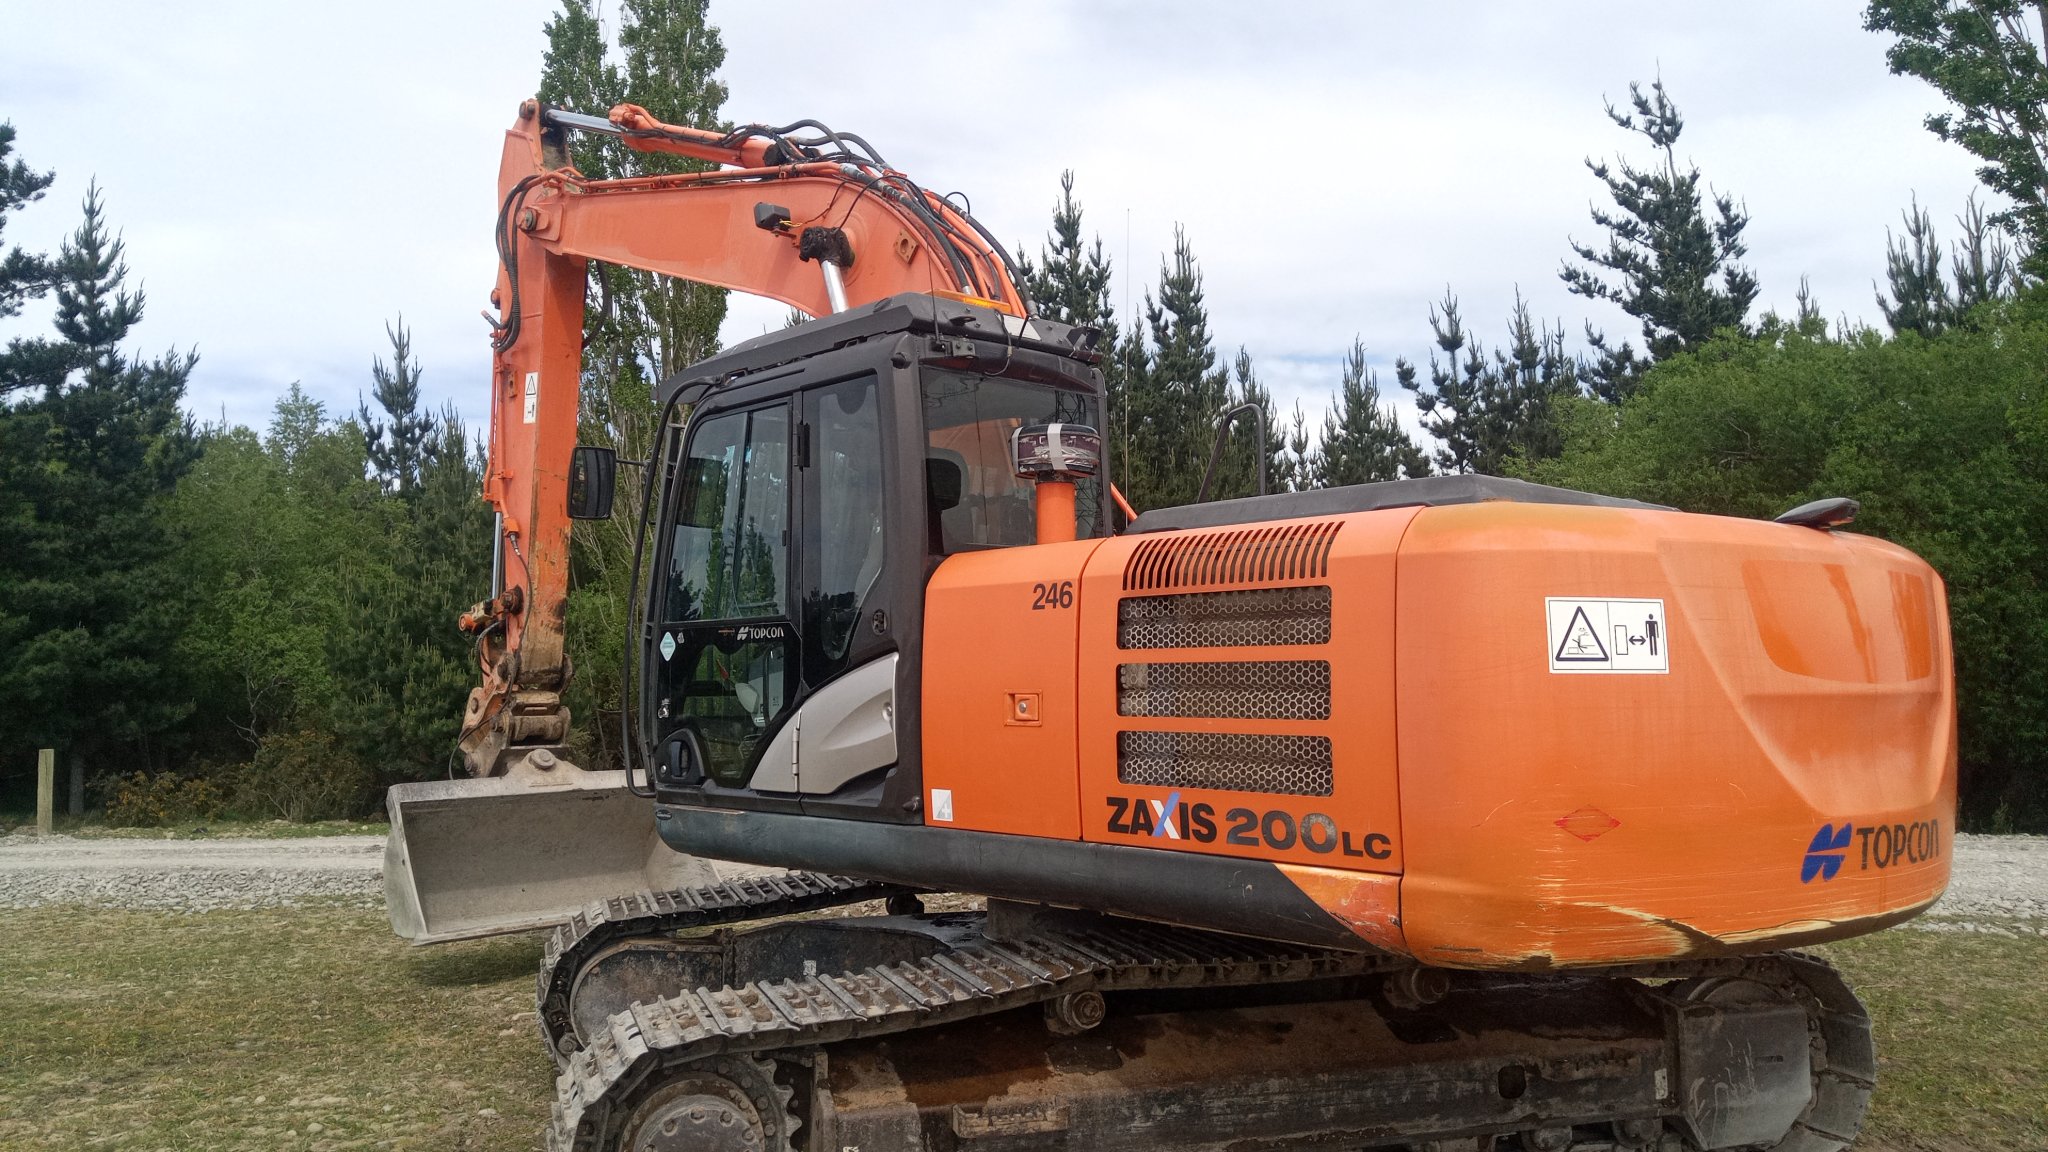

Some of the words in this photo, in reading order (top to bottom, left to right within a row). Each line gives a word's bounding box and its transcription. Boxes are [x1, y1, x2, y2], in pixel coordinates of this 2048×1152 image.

[1032, 581, 1073, 610] 246
[749, 626, 785, 640] TOPCON
[1106, 791, 1218, 844] ZAXIS
[1856, 818, 1939, 870] TOPCON
